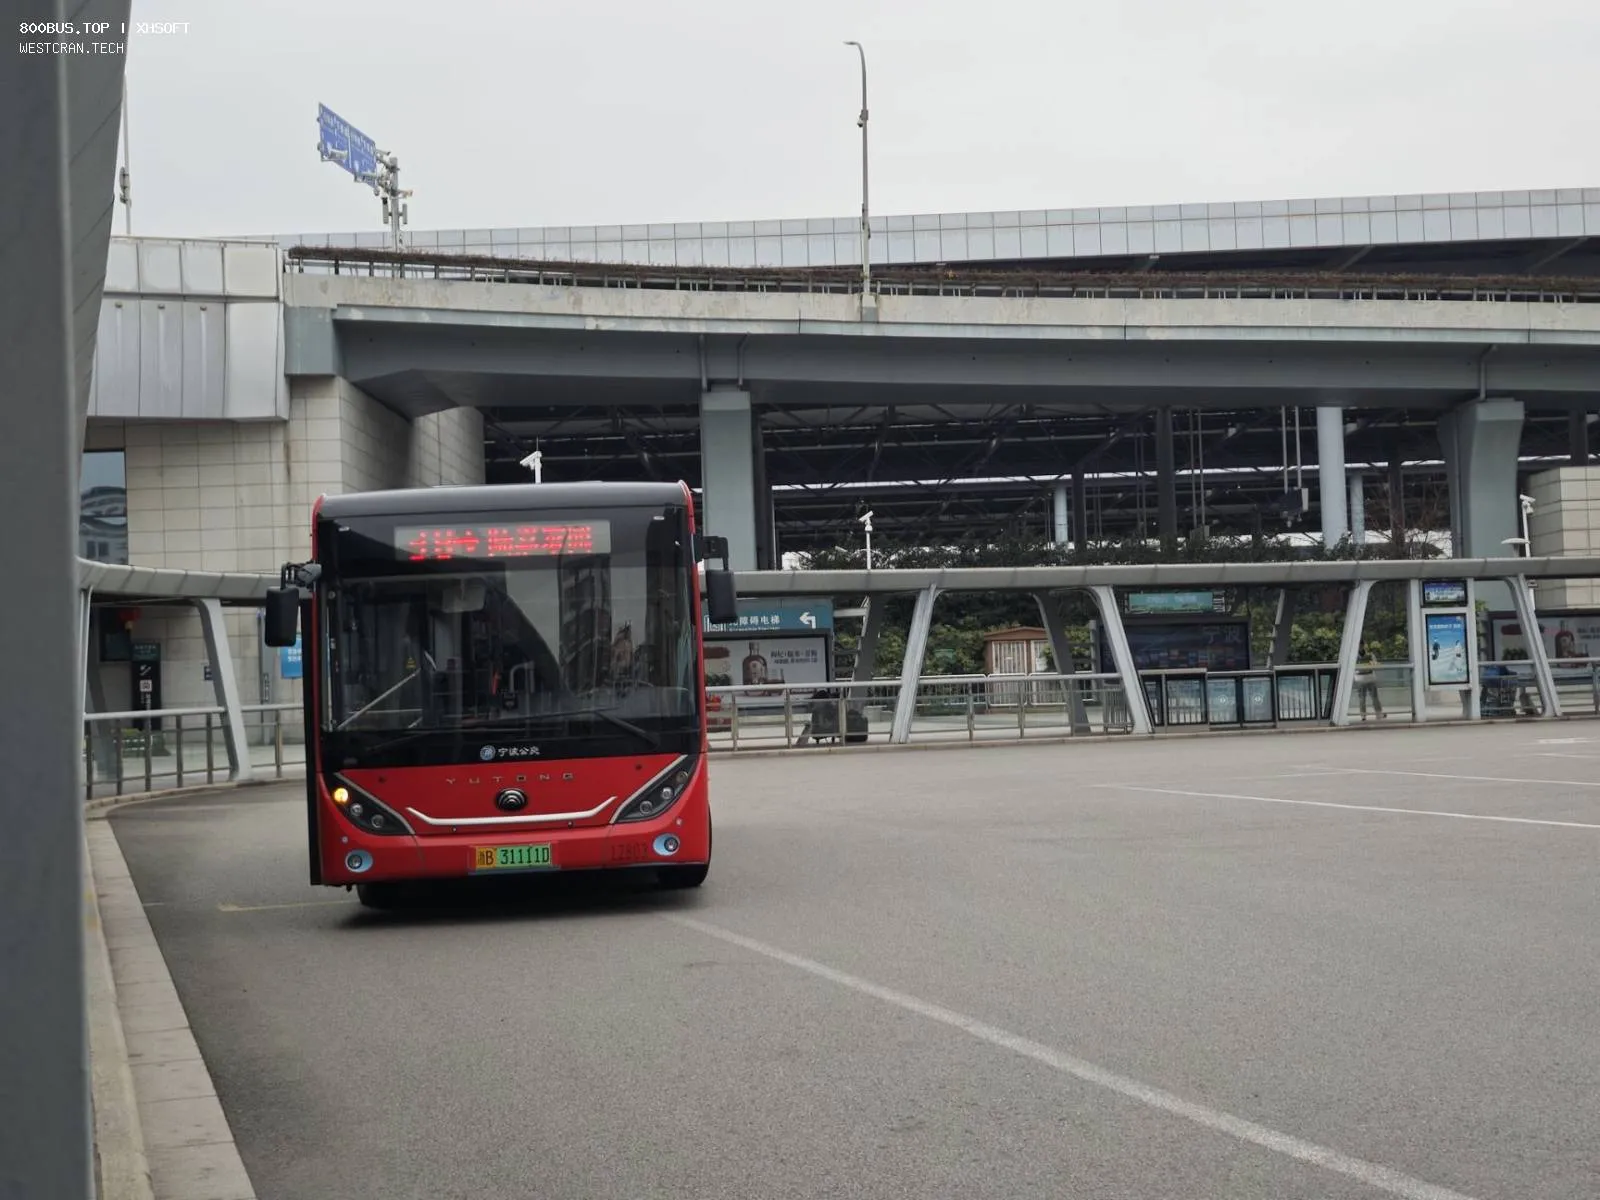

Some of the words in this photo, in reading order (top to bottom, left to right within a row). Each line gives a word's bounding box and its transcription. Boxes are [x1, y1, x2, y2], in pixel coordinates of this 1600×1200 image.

[497, 745, 540, 757] 宁波公交
[445, 772, 575, 785] YUTONG
